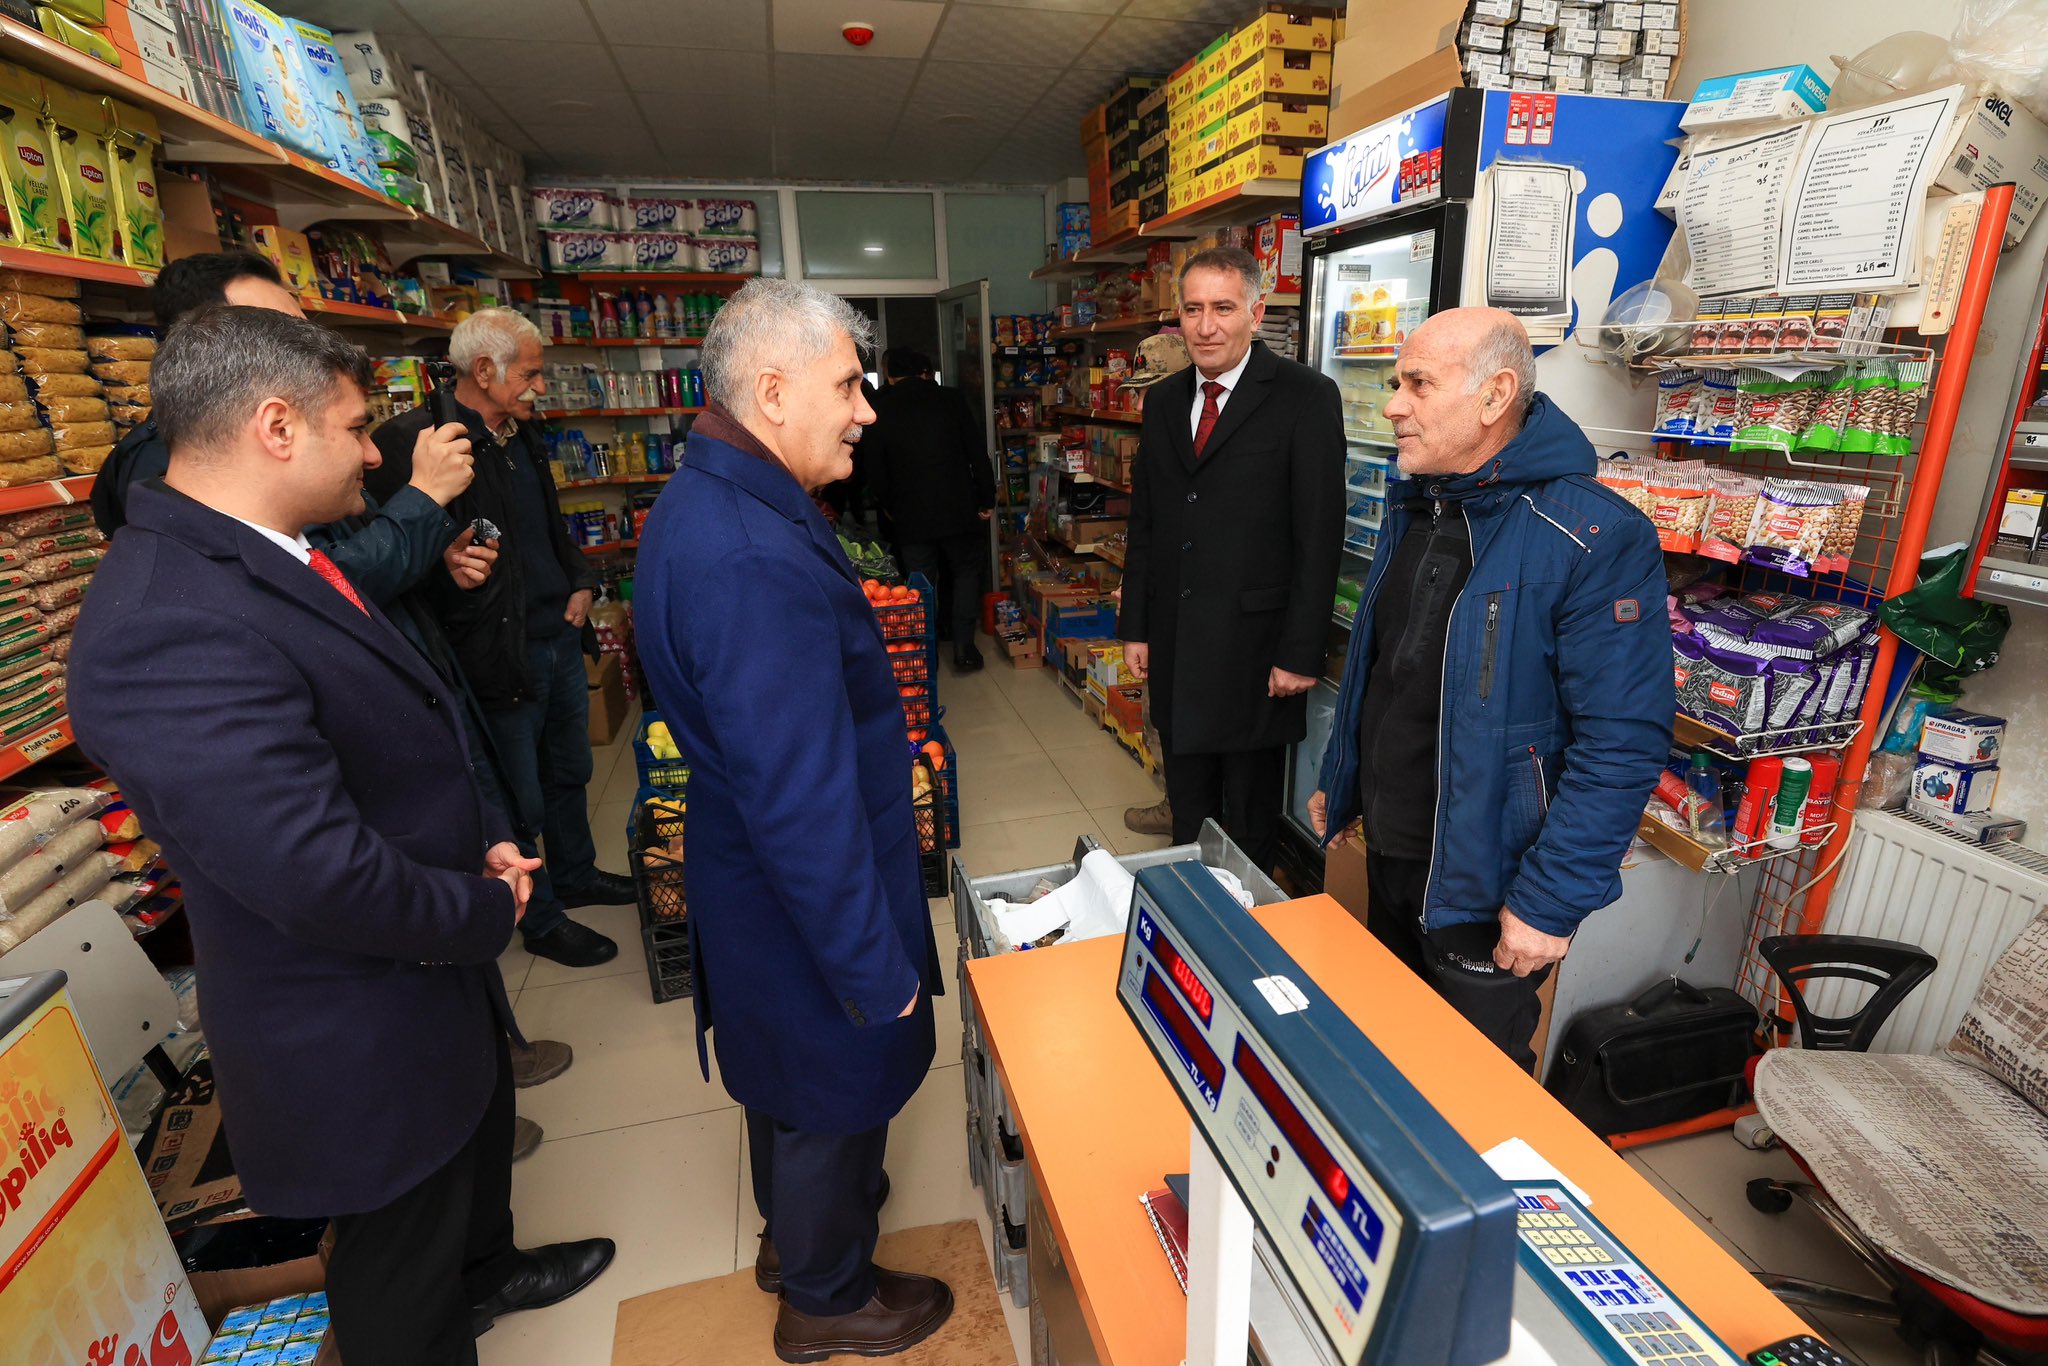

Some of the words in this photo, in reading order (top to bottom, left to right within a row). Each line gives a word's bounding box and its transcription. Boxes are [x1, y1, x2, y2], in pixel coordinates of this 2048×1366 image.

[233, 7, 270, 40] molfix
[307, 46, 336, 64] molfix
[20, 149, 43, 164] Lipton
[82, 167, 103, 181] Lipton
[28, 179, 48, 190] YELLOW
[32, 187, 48, 197] LABEL
[551, 198, 594, 219] Solo
[636, 204, 676, 228] Solo
[704, 204, 743, 226] Solo
[564, 239, 606, 263] Solo
[636, 240, 678, 262] Solo
[708, 246, 748, 267] Solo
[1752, 405, 1776, 413] tadım
[1655, 509, 1677, 518] tadım
[1713, 513, 1730, 523] tadım
[1771, 519, 1800, 532] tadım
[1711, 687, 1736, 700] tadım
[1935, 722, 1966, 734] iPRAGAZ
[60, 798, 80, 814] 600
[1140, 916, 1152, 942] Kg
[1456, 955, 1494, 968] Columbia
[1462, 964, 1494, 973] TITANIUM
[1189, 1062, 1199, 1083] TL
[1204, 1085, 1217, 1110] Kg
[1352, 1199, 1371, 1240] TL
[1322, 1221, 1362, 1285] DENGE
[1317, 1239, 1346, 1287] SIFIR
